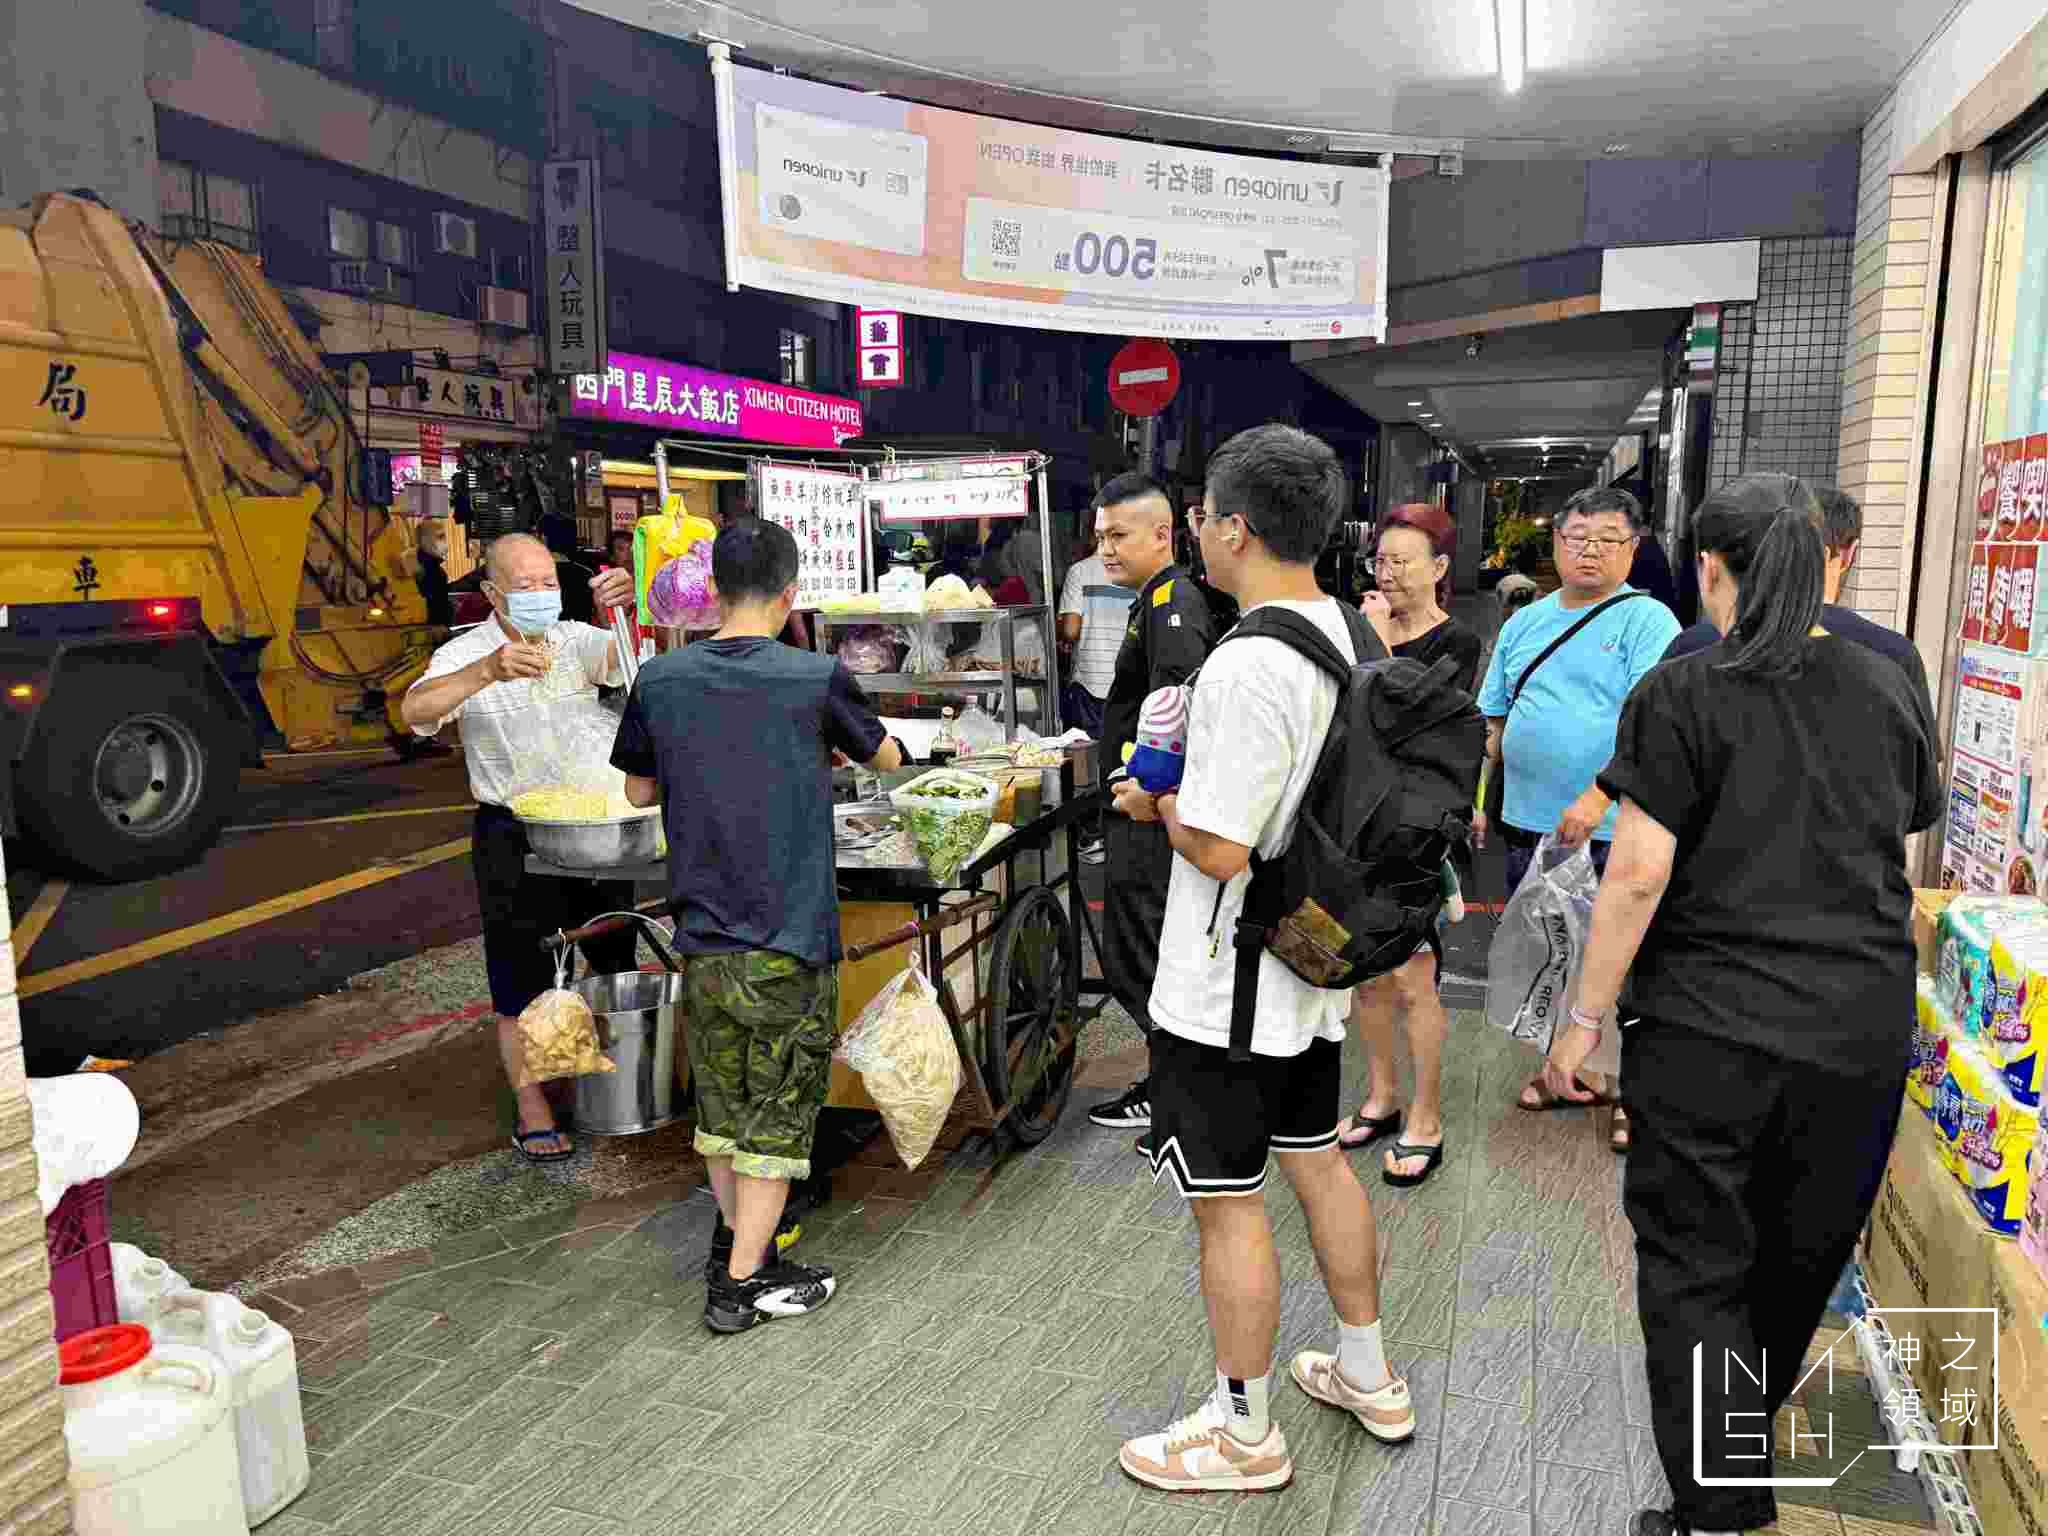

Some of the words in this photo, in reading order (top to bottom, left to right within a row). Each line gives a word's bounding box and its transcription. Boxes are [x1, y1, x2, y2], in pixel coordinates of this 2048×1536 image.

[556, 224, 585, 350] 整人玩具
[37, 360, 87, 420] 局
[576, 366, 739, 425] 西門星辰大飯店
[743, 386, 784, 411] XIMEN
[785, 394, 829, 420] CITIZEN
[830, 401, 862, 427] HOTEL
[72, 555, 101, 600] 車
